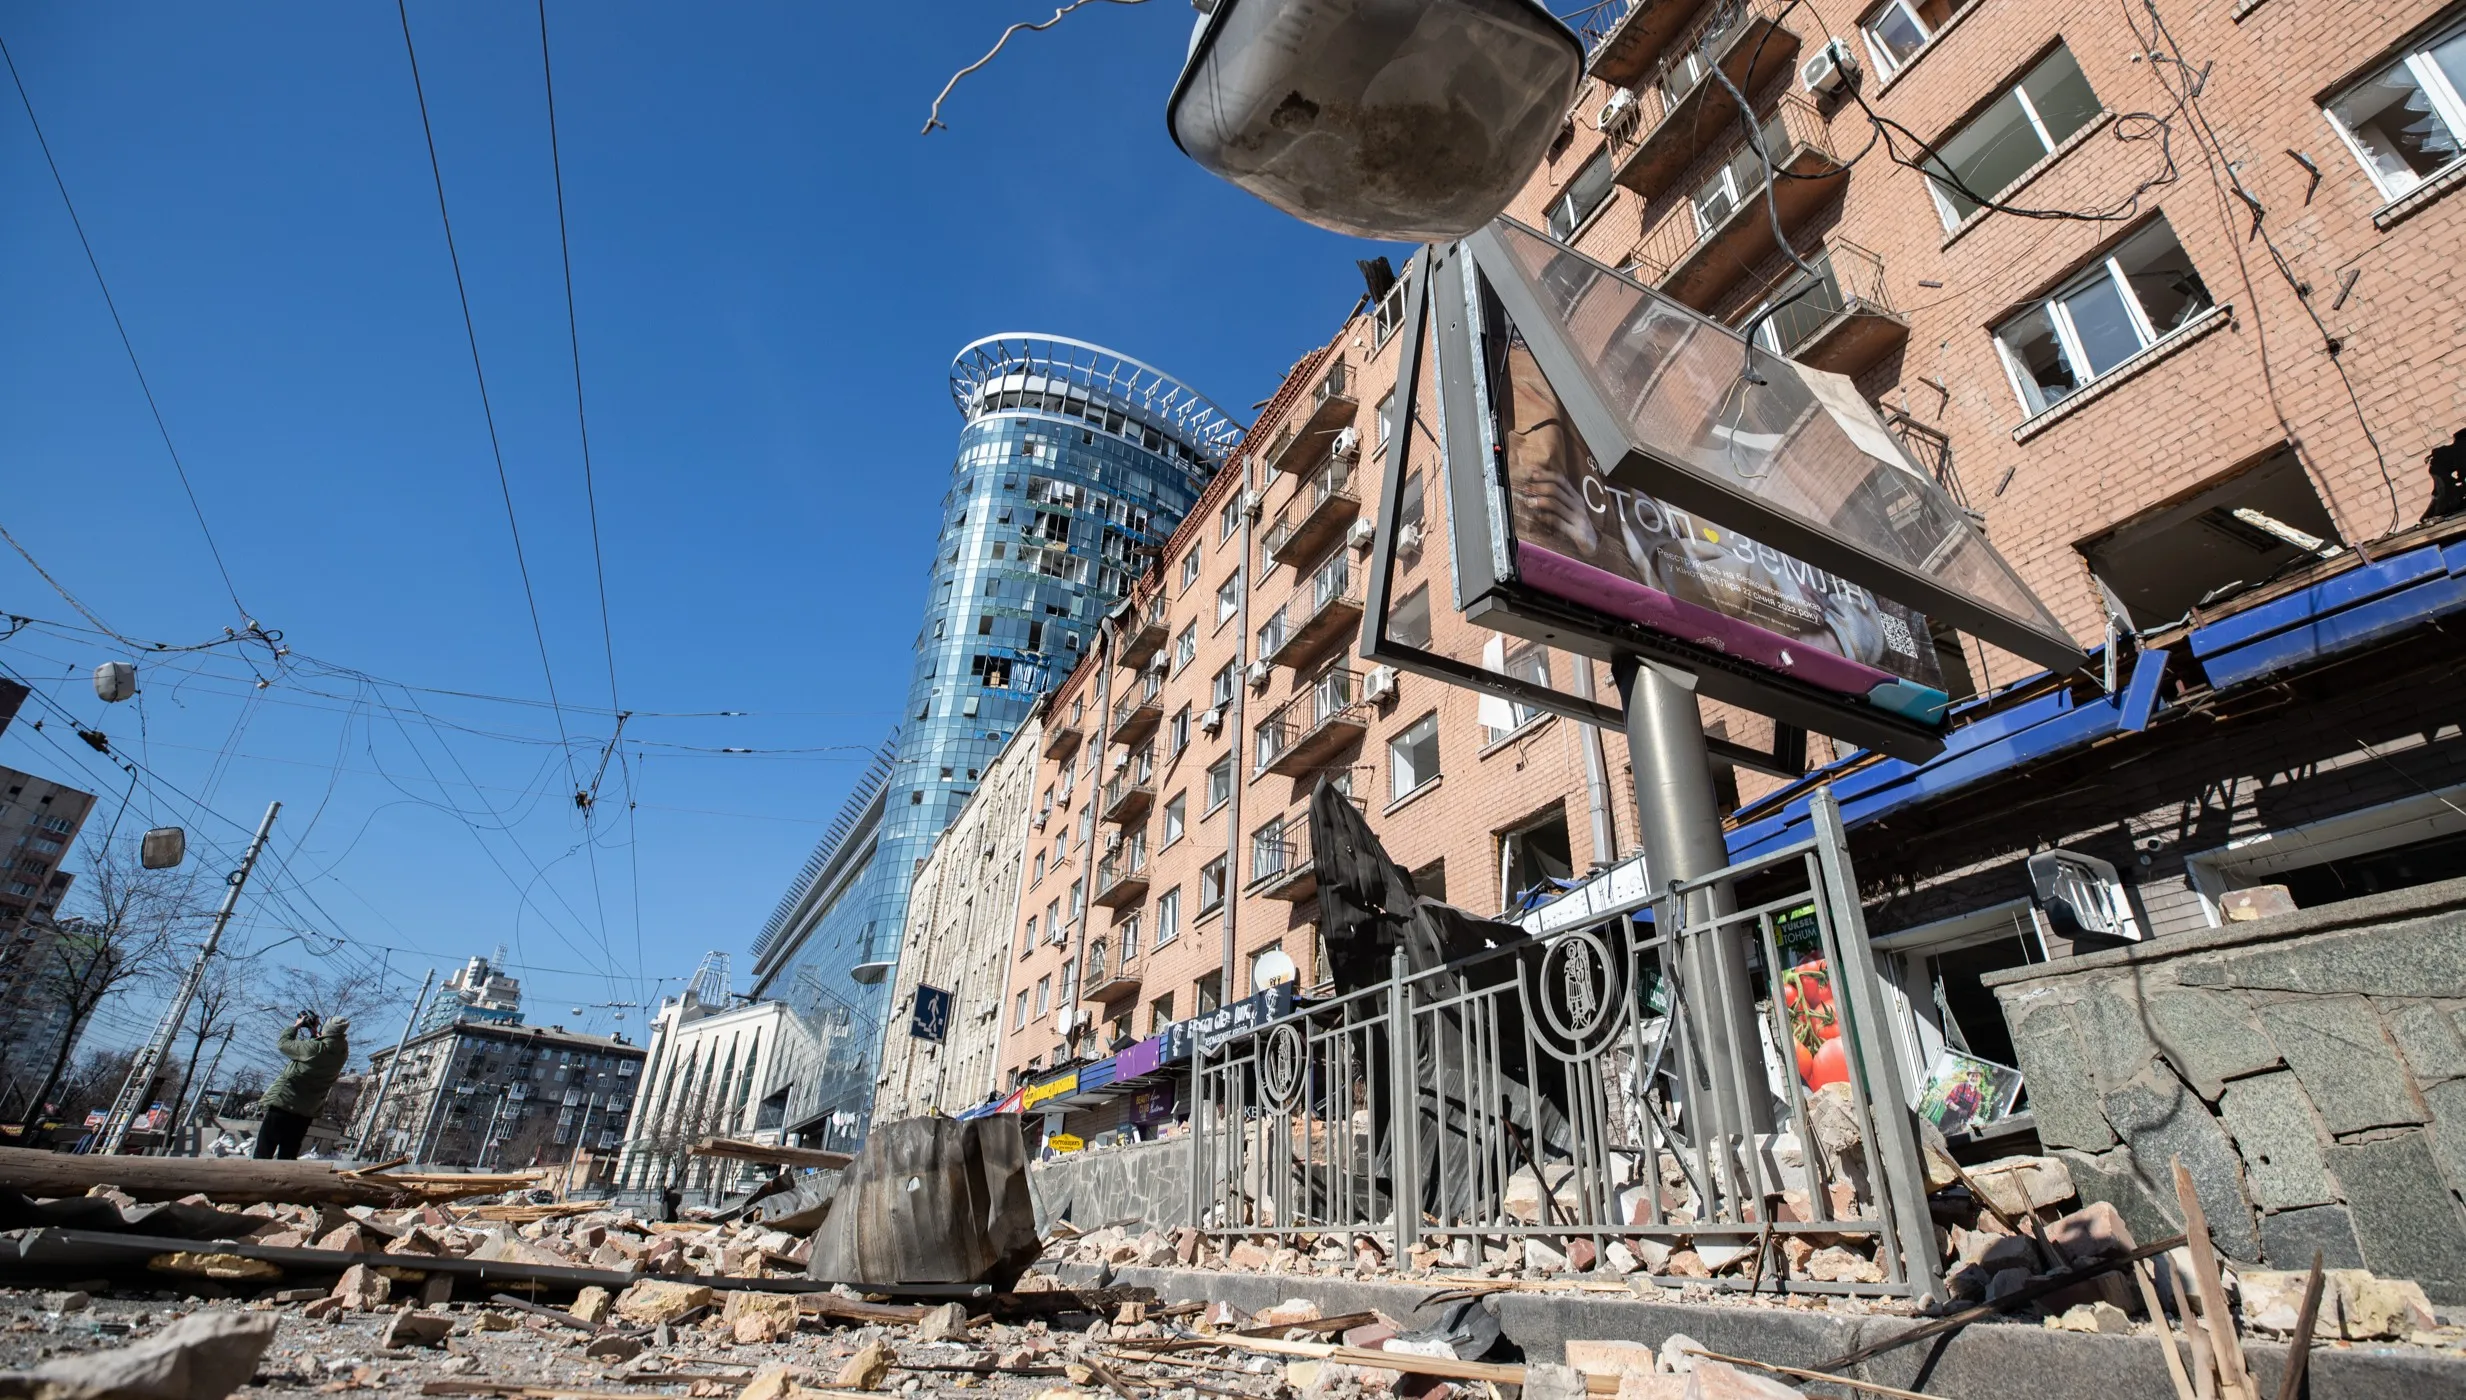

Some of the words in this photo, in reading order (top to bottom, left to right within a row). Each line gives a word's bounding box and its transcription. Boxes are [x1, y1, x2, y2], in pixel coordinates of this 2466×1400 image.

[1656, 547, 1721, 576] Реєструйтесь
[1723, 570, 1735, 580] на
[1736, 572, 1797, 602] безкоштовний
[1798, 597, 1822, 612] показ
[1743, 587, 1752, 597] 22
[1777, 600, 1797, 614] 2022
[1798, 608, 1819, 624] року
[1784, 928, 1817, 944] TOHUM
[1214, 1009, 1231, 1030] de
